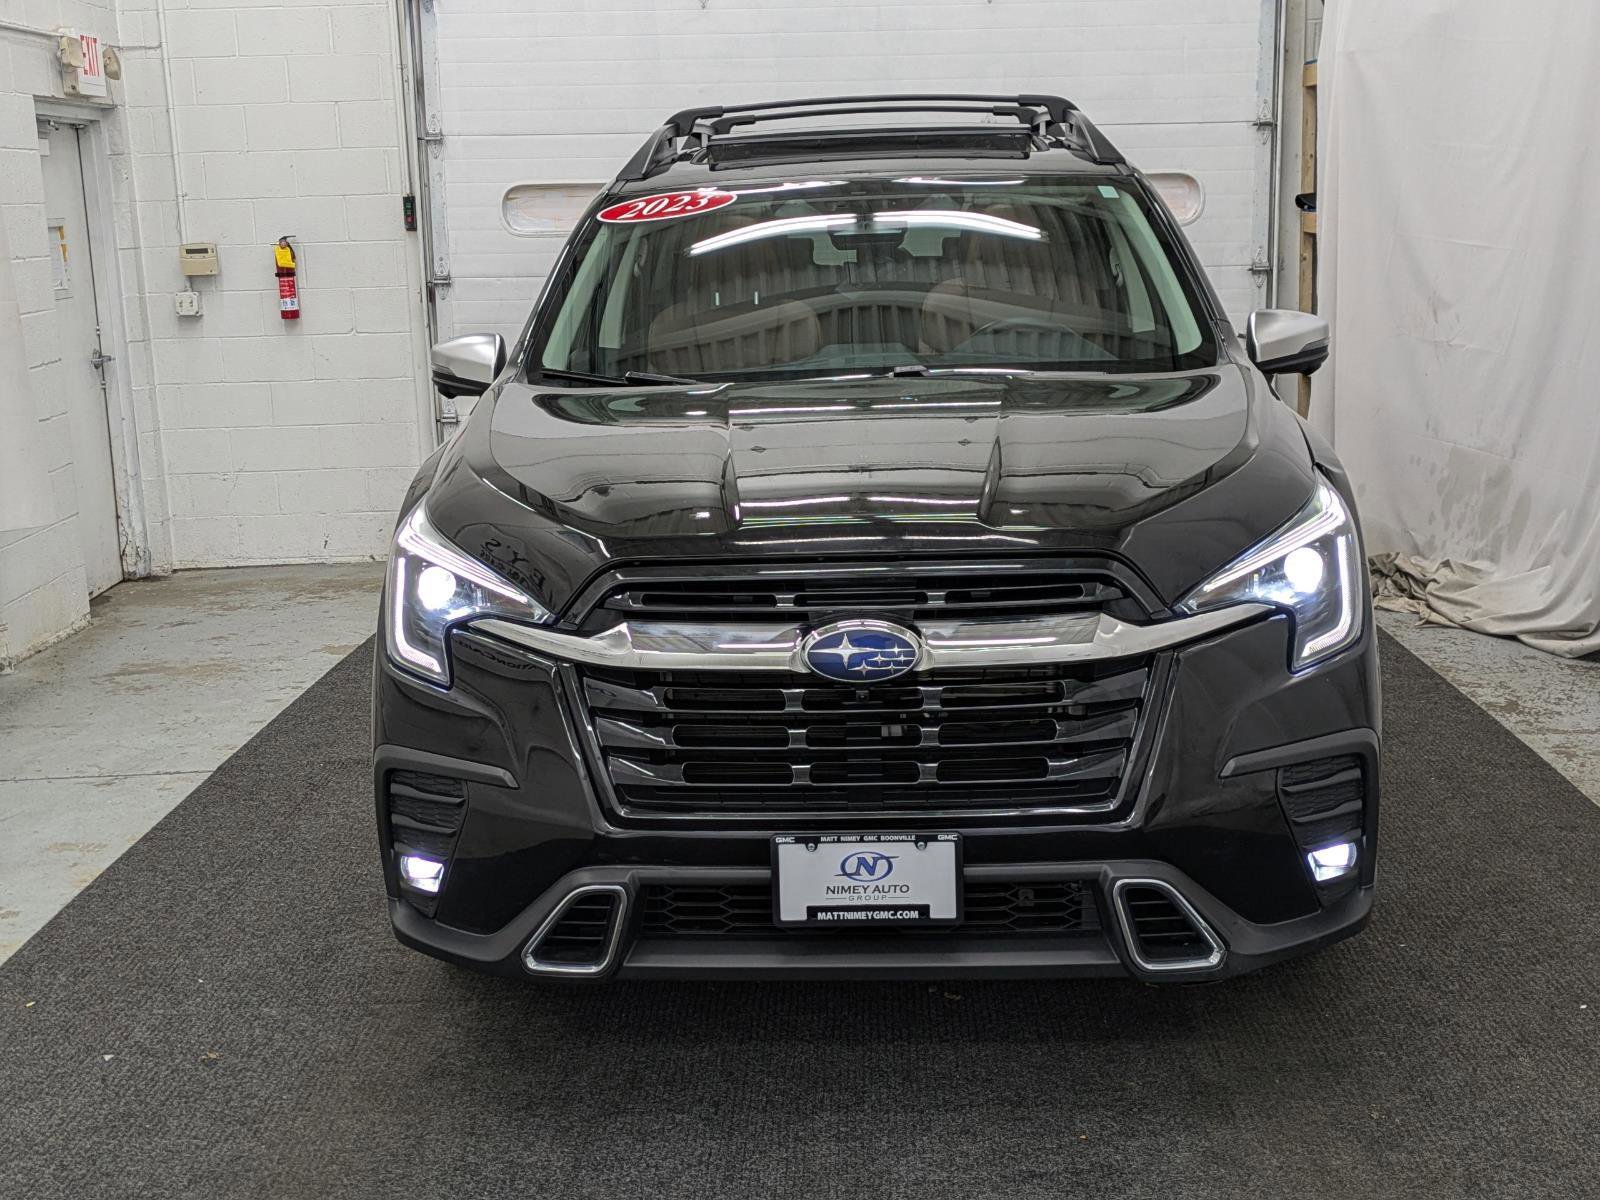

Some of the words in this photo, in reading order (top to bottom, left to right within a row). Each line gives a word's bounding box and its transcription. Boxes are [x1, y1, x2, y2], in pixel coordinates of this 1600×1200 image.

[80, 34, 100, 77] EXIT
[616, 193, 713, 220] 2023
[880, 834, 916, 842] BOONVILLE
[825, 884, 870, 895] NIMEY
[872, 884, 910, 894] AUTO
[848, 894, 888, 902] GROUP
[817, 910, 919, 921] MATTNIMEYGMC.COM
